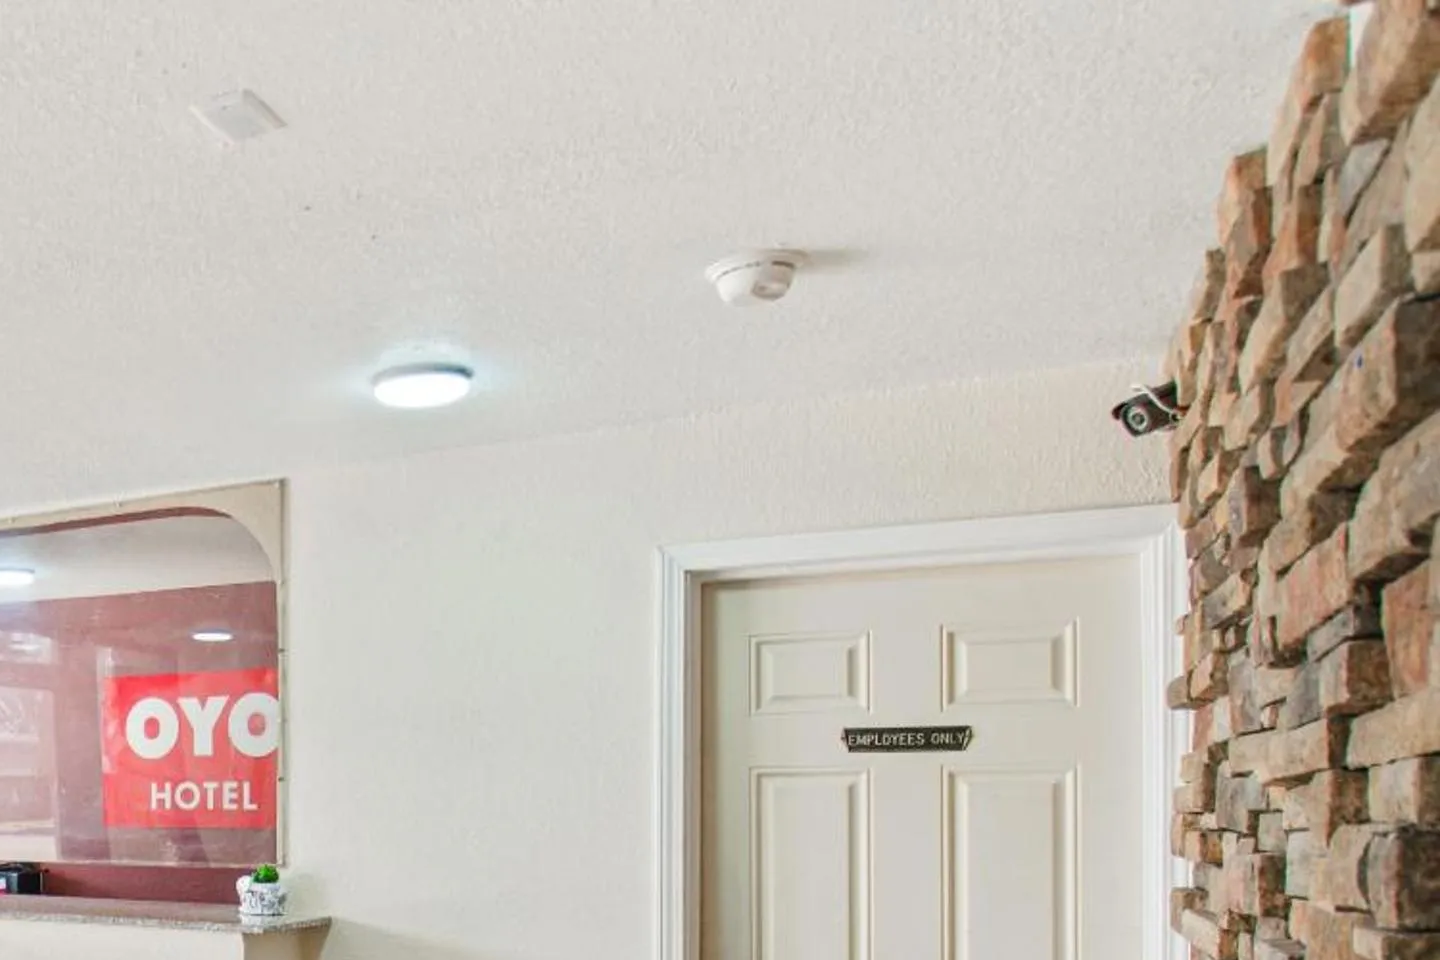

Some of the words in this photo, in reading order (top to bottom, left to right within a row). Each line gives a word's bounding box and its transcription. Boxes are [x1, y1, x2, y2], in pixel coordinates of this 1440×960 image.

[125, 692, 282, 759] OYO
[847, 732, 925, 746] EMPLOYEES
[930, 731, 967, 745] ONLY
[150, 780, 258, 811] HOTEL
